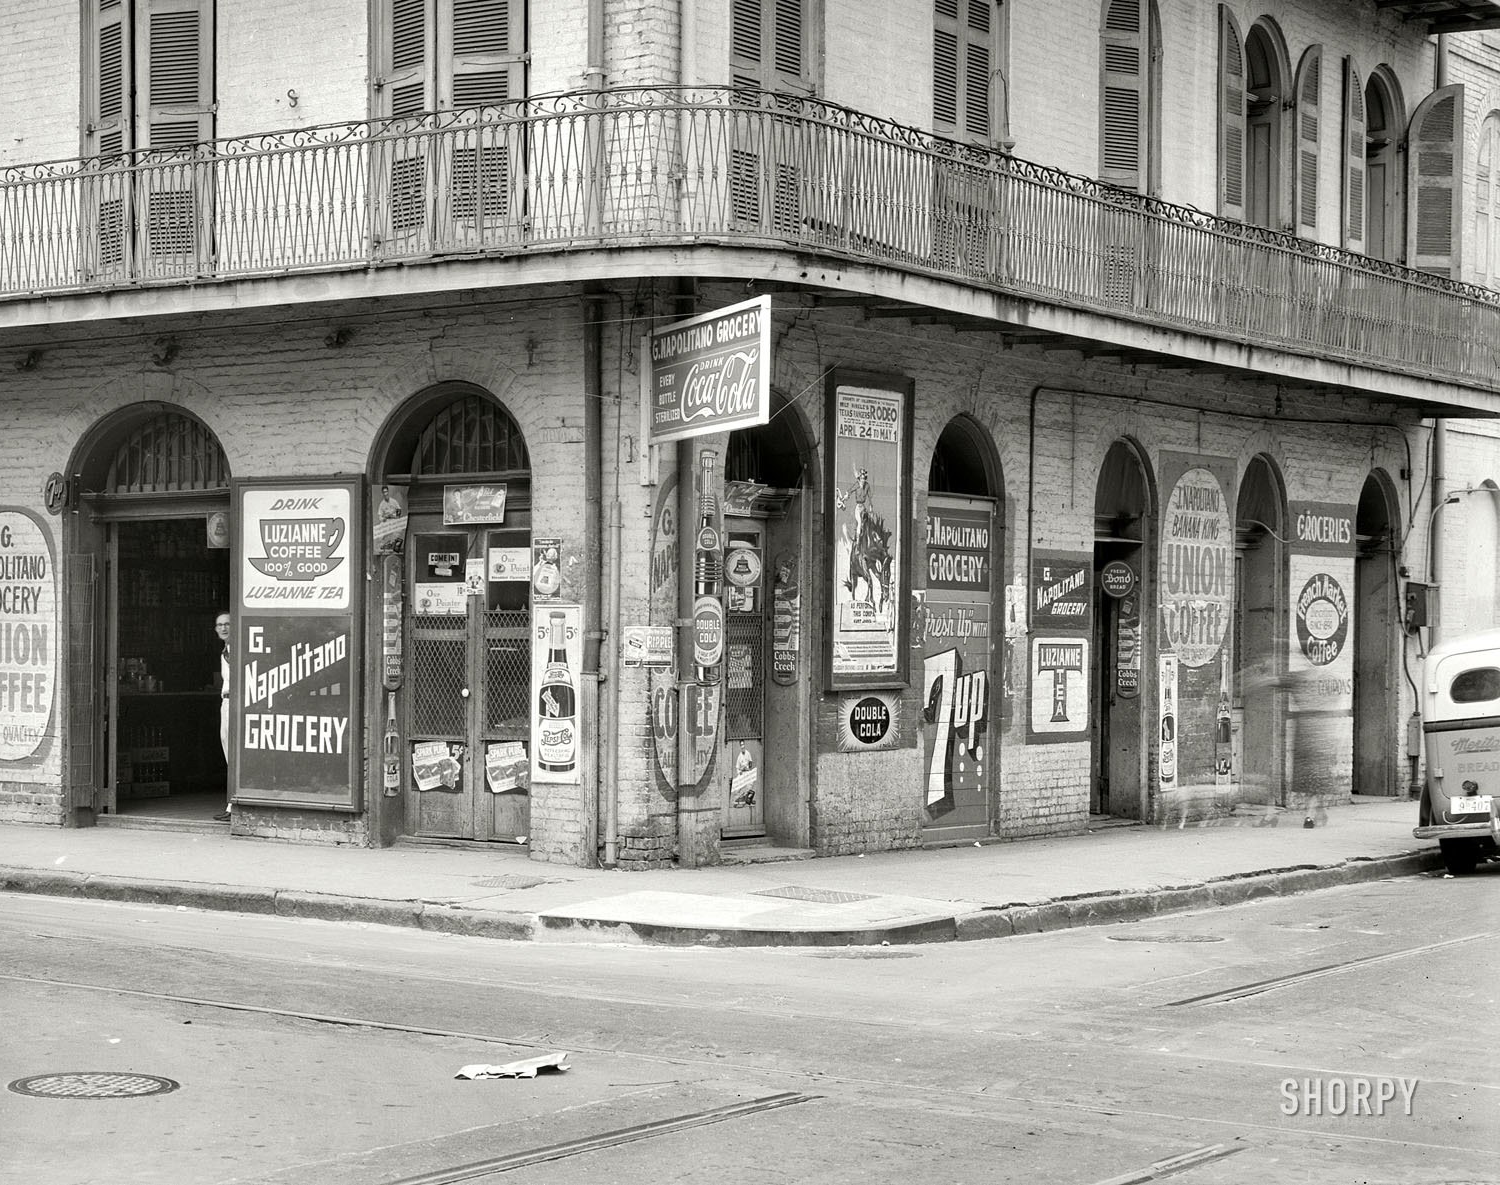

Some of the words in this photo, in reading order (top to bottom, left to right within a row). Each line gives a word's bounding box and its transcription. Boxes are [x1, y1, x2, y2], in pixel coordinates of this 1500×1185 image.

[716, 310, 761, 343] GROCERY
[700, 357, 725, 370] DRINK
[659, 373, 675, 387] EVERY
[659, 391, 676, 405] BOTTLE
[655, 408, 680, 423] STERILIZED
[870, 405, 897, 422] RODEO
[860, 426, 872, 438] 24
[270, 498, 324, 510] DRINK
[265, 523, 326, 543] LUZIANNE
[1172, 514, 1201, 538] BANANA
[1201, 518, 1220, 540] KING
[1297, 514, 1351, 544] GROCERIES
[1, 525, 14, 548] G.
[270, 546, 321, 558] COFFEE
[430, 554, 447, 562] COME
[265, 561, 293, 576] 100%
[297, 563, 328, 572] GOOD
[929, 553, 984, 583] GROCERY
[1043, 567, 1053, 582] G.
[1167, 544, 1226, 596] UNION
[1104, 573, 1131, 584] Bond
[245, 586, 317, 599] LUZIANNE
[317, 586, 344, 599] TEA
[1037, 569, 1085, 610] NAPOLITANO
[1051, 602, 1087, 615] GROCERY
[696, 619, 720, 630] DOUBLE
[973, 622, 988, 637] WITH
[1169, 601, 1221, 645] COFFEE
[248, 626, 271, 653] G.
[700, 632, 717, 643] COLA
[774, 651, 796, 661] Cobbs
[1307, 635, 1338, 662] Coffee
[1041, 648, 1081, 667] LUZIANNE
[244, 634, 346, 709] Napolitano
[1056, 669, 1064, 716] TEA
[855, 706, 887, 720] DOUBLE
[244, 713, 348, 754] GROCERY
[860, 723, 881, 737] COLA
[1457, 761, 1499, 773] BREAD
